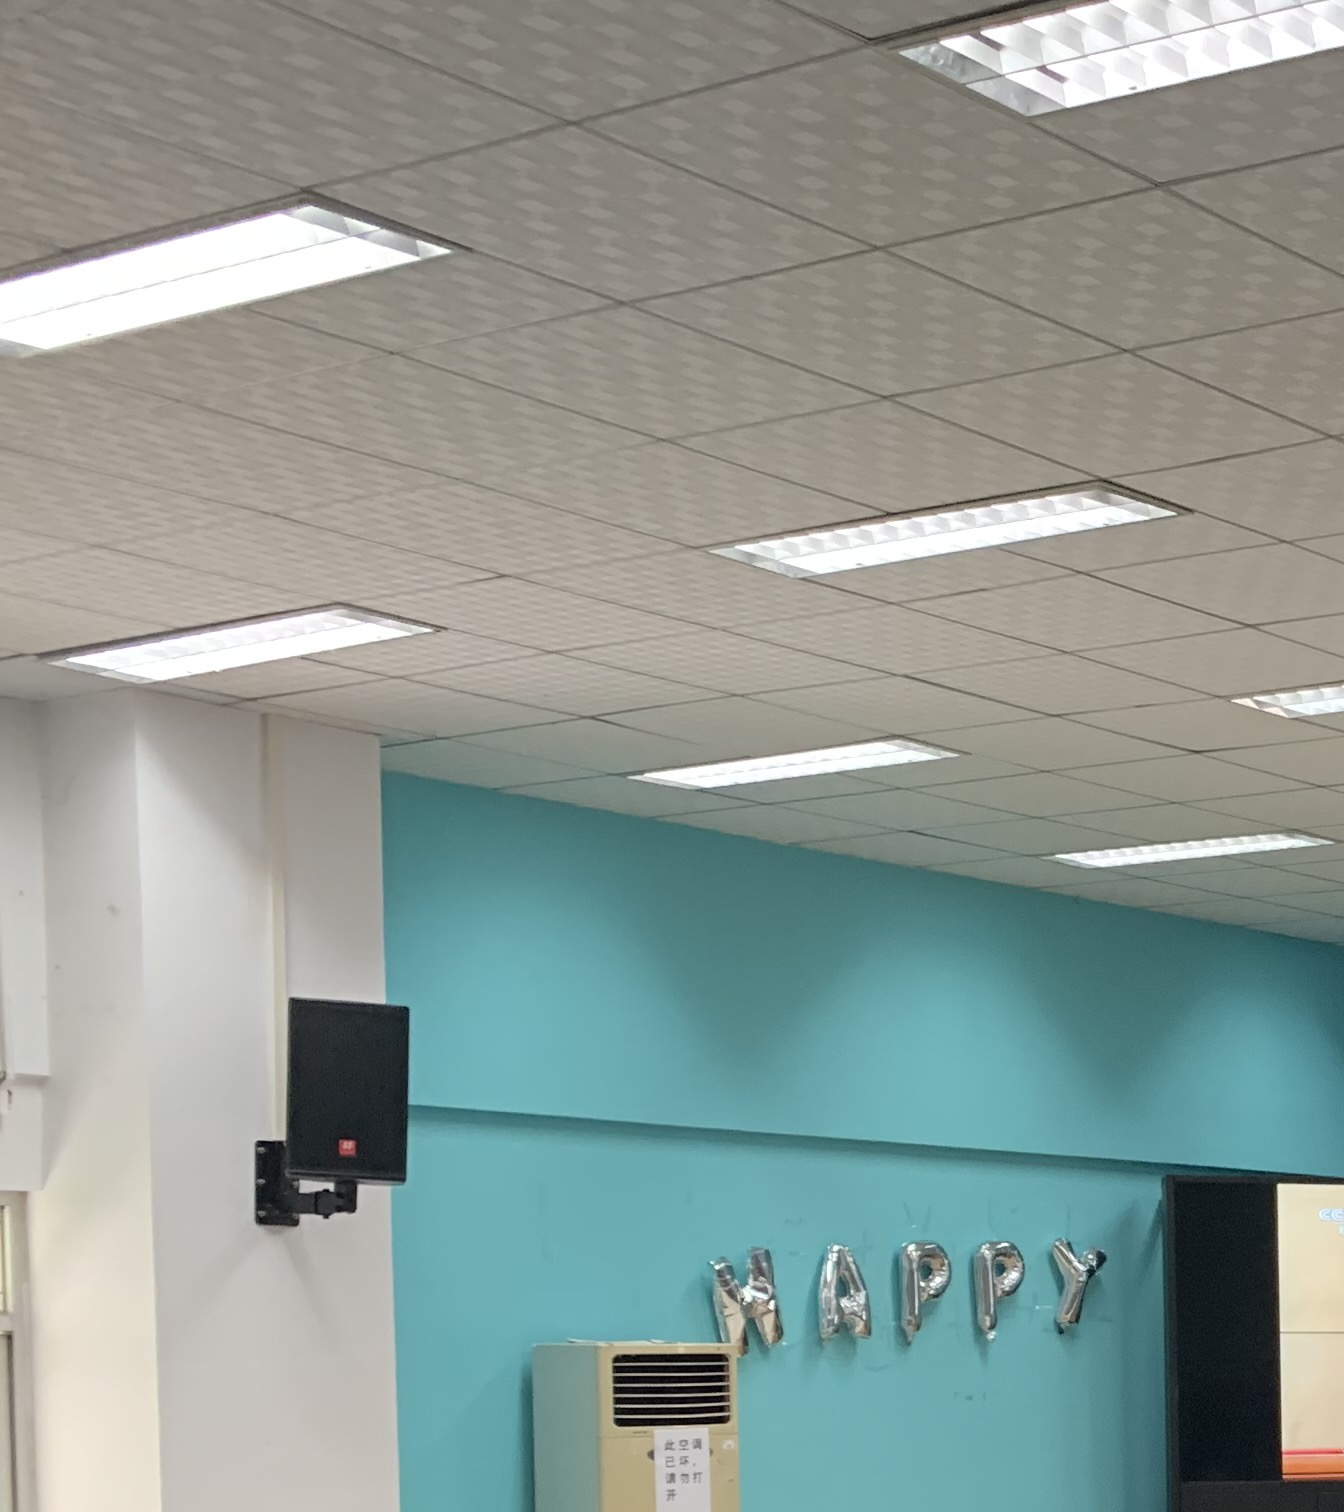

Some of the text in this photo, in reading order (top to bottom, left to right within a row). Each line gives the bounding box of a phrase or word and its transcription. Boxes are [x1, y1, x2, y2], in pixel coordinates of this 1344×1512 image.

[707, 1236, 1108, 1355] HAPPY
[664, 1438, 703, 1451] 此空调
[665, 1472, 702, 1485] 请勿打
[666, 1489, 677, 1502] 开
